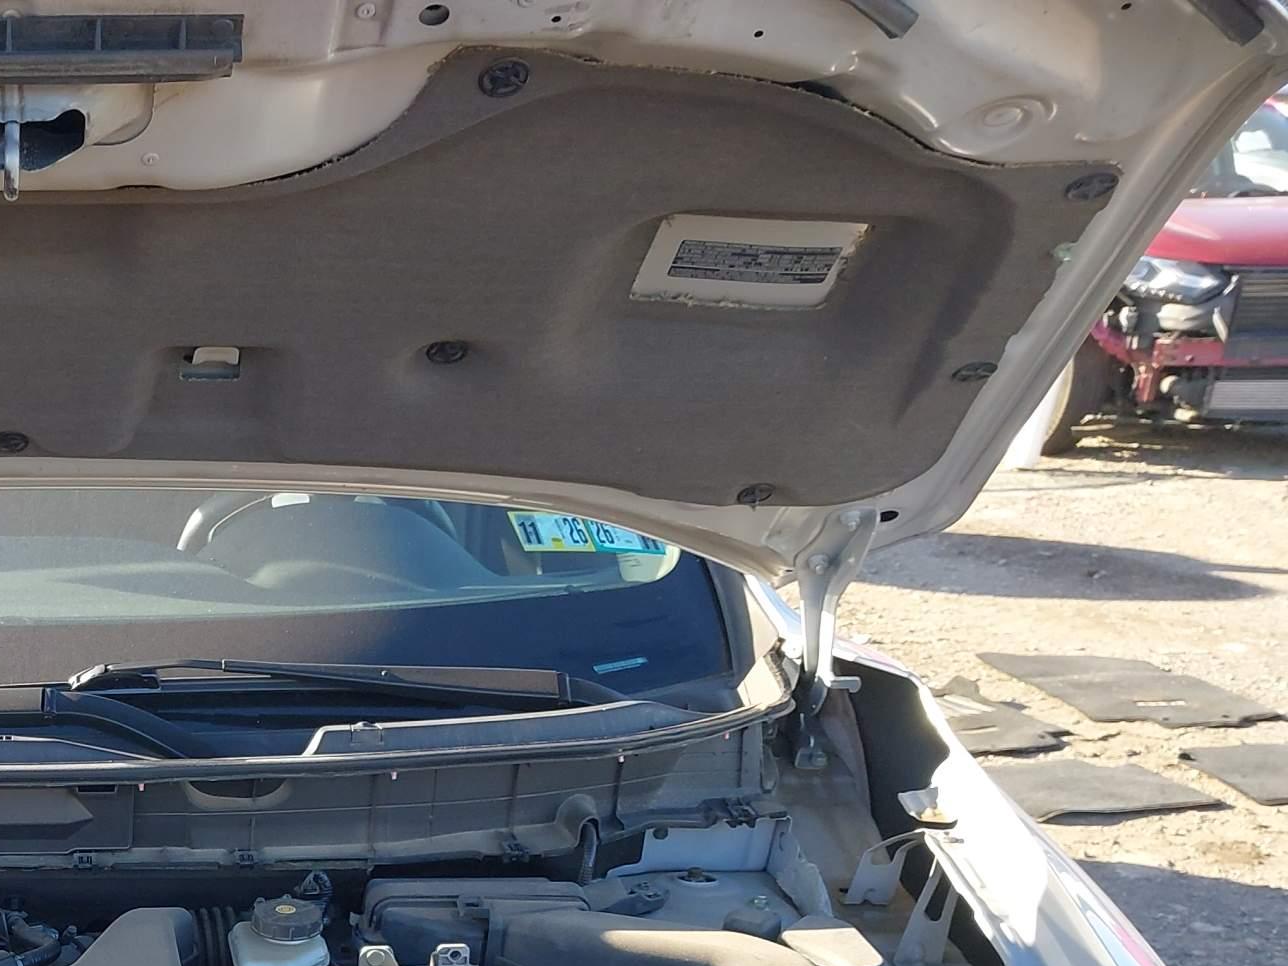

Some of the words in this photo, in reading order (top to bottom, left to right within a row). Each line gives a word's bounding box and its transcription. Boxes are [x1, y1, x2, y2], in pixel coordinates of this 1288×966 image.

[518, 521, 543, 545] 11
[563, 517, 589, 545] 26
[591, 519, 616, 545] 26
